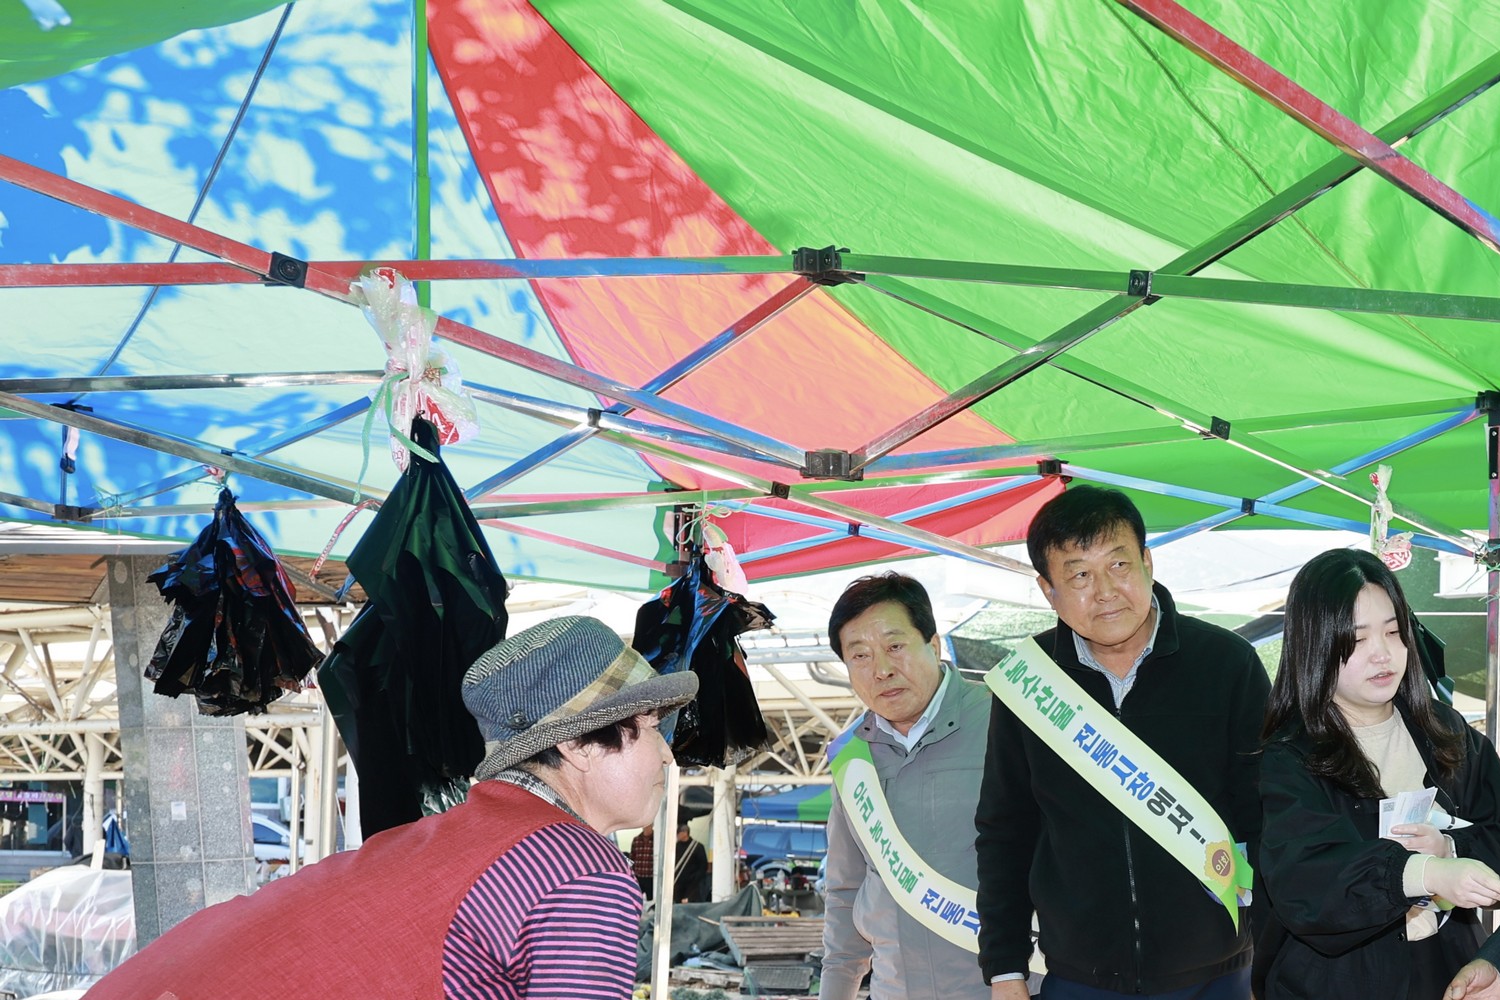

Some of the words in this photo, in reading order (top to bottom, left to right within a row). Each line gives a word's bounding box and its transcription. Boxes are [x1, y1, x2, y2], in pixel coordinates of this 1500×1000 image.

[1004, 663, 1083, 731] 농수산물,
[1072, 723, 1207, 847] 전통시장에서!
[853, 783, 875, 824] 우리
[869, 821, 925, 895] 농수산물,
[1214, 851, 1231, 877] 의회
